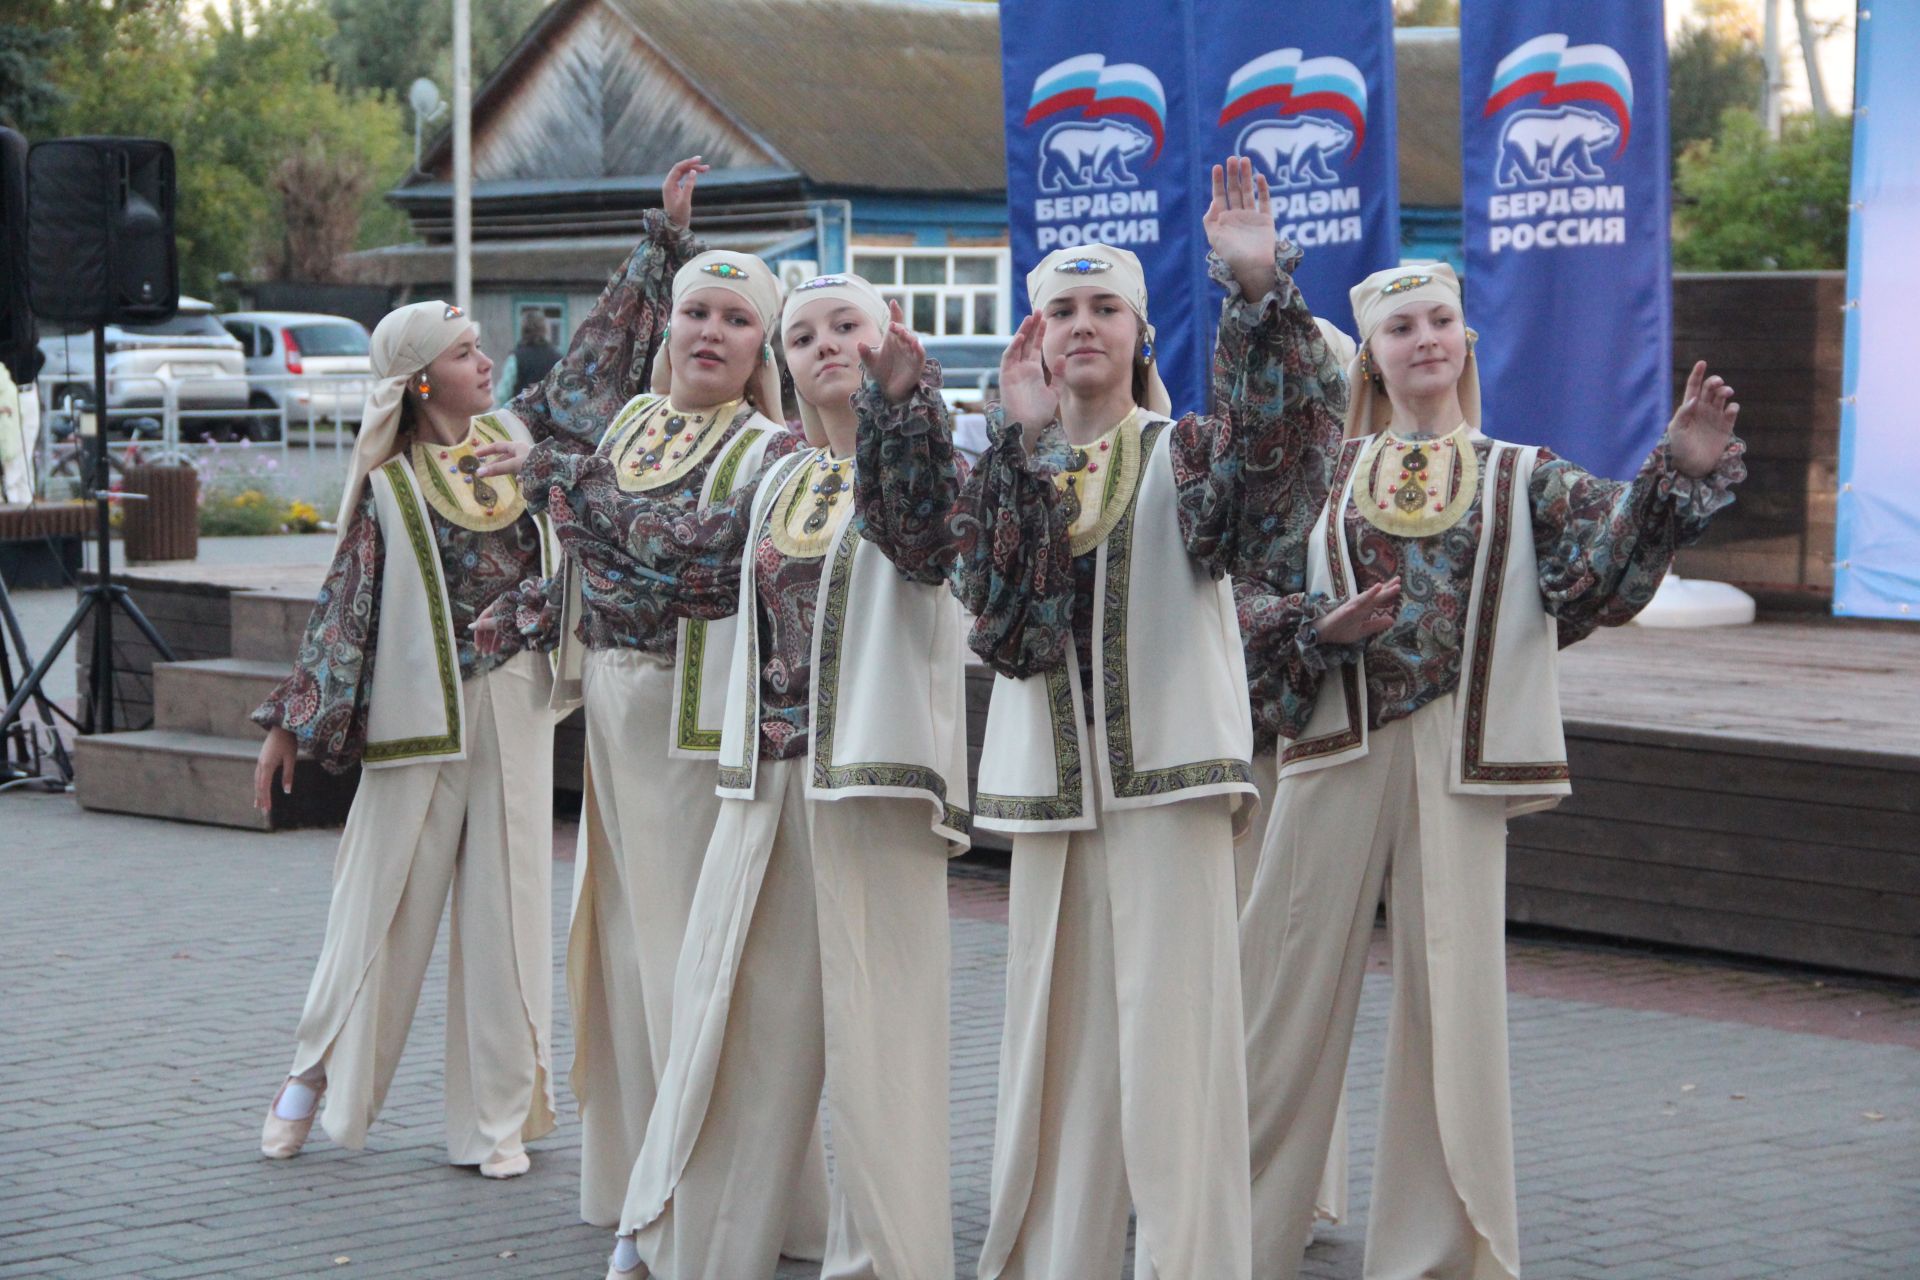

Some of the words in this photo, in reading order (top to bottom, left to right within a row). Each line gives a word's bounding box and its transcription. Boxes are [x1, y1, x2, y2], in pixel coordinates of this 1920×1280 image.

[1035, 190, 1158, 221] БЕРДӘМ
[1254, 186, 1360, 219] РДӘМ
[1489, 185, 1625, 220] БЕРДӘМ
[1037, 218, 1160, 251] РОССИЯ
[1276, 215, 1362, 247] ССИЯ
[1490, 216, 1626, 253] РОССИЯ
